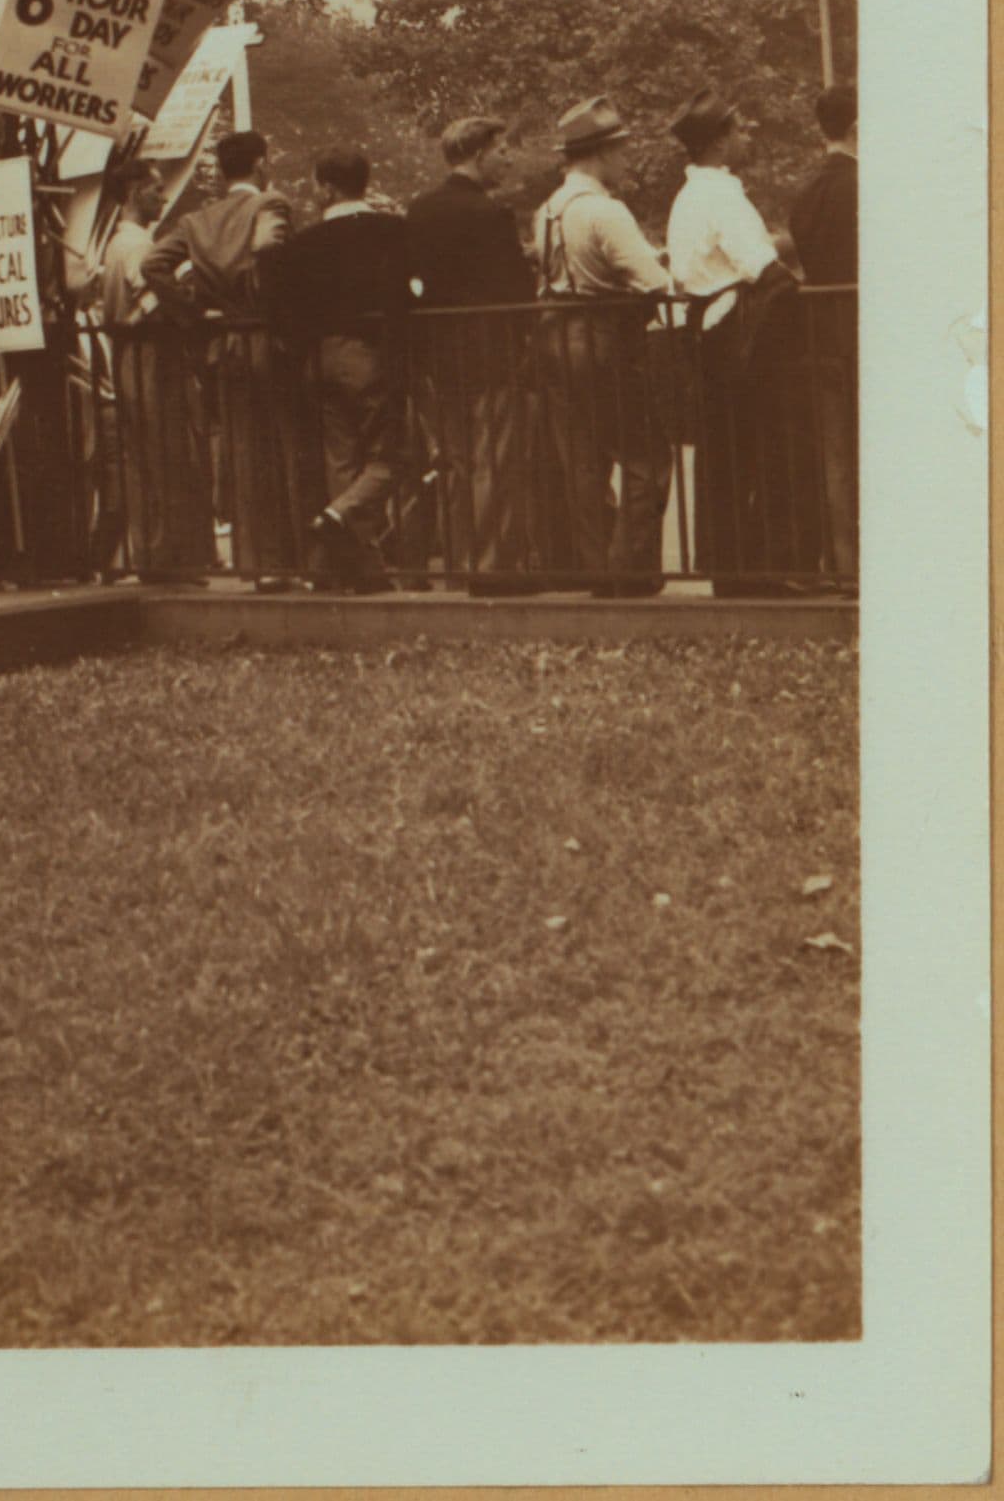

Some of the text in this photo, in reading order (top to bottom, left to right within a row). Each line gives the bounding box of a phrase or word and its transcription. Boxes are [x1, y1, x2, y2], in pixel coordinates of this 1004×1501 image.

[52, 36, 91, 57] FOR
[70, 11, 132, 49] DAY
[30, 52, 92, 86] ALL
